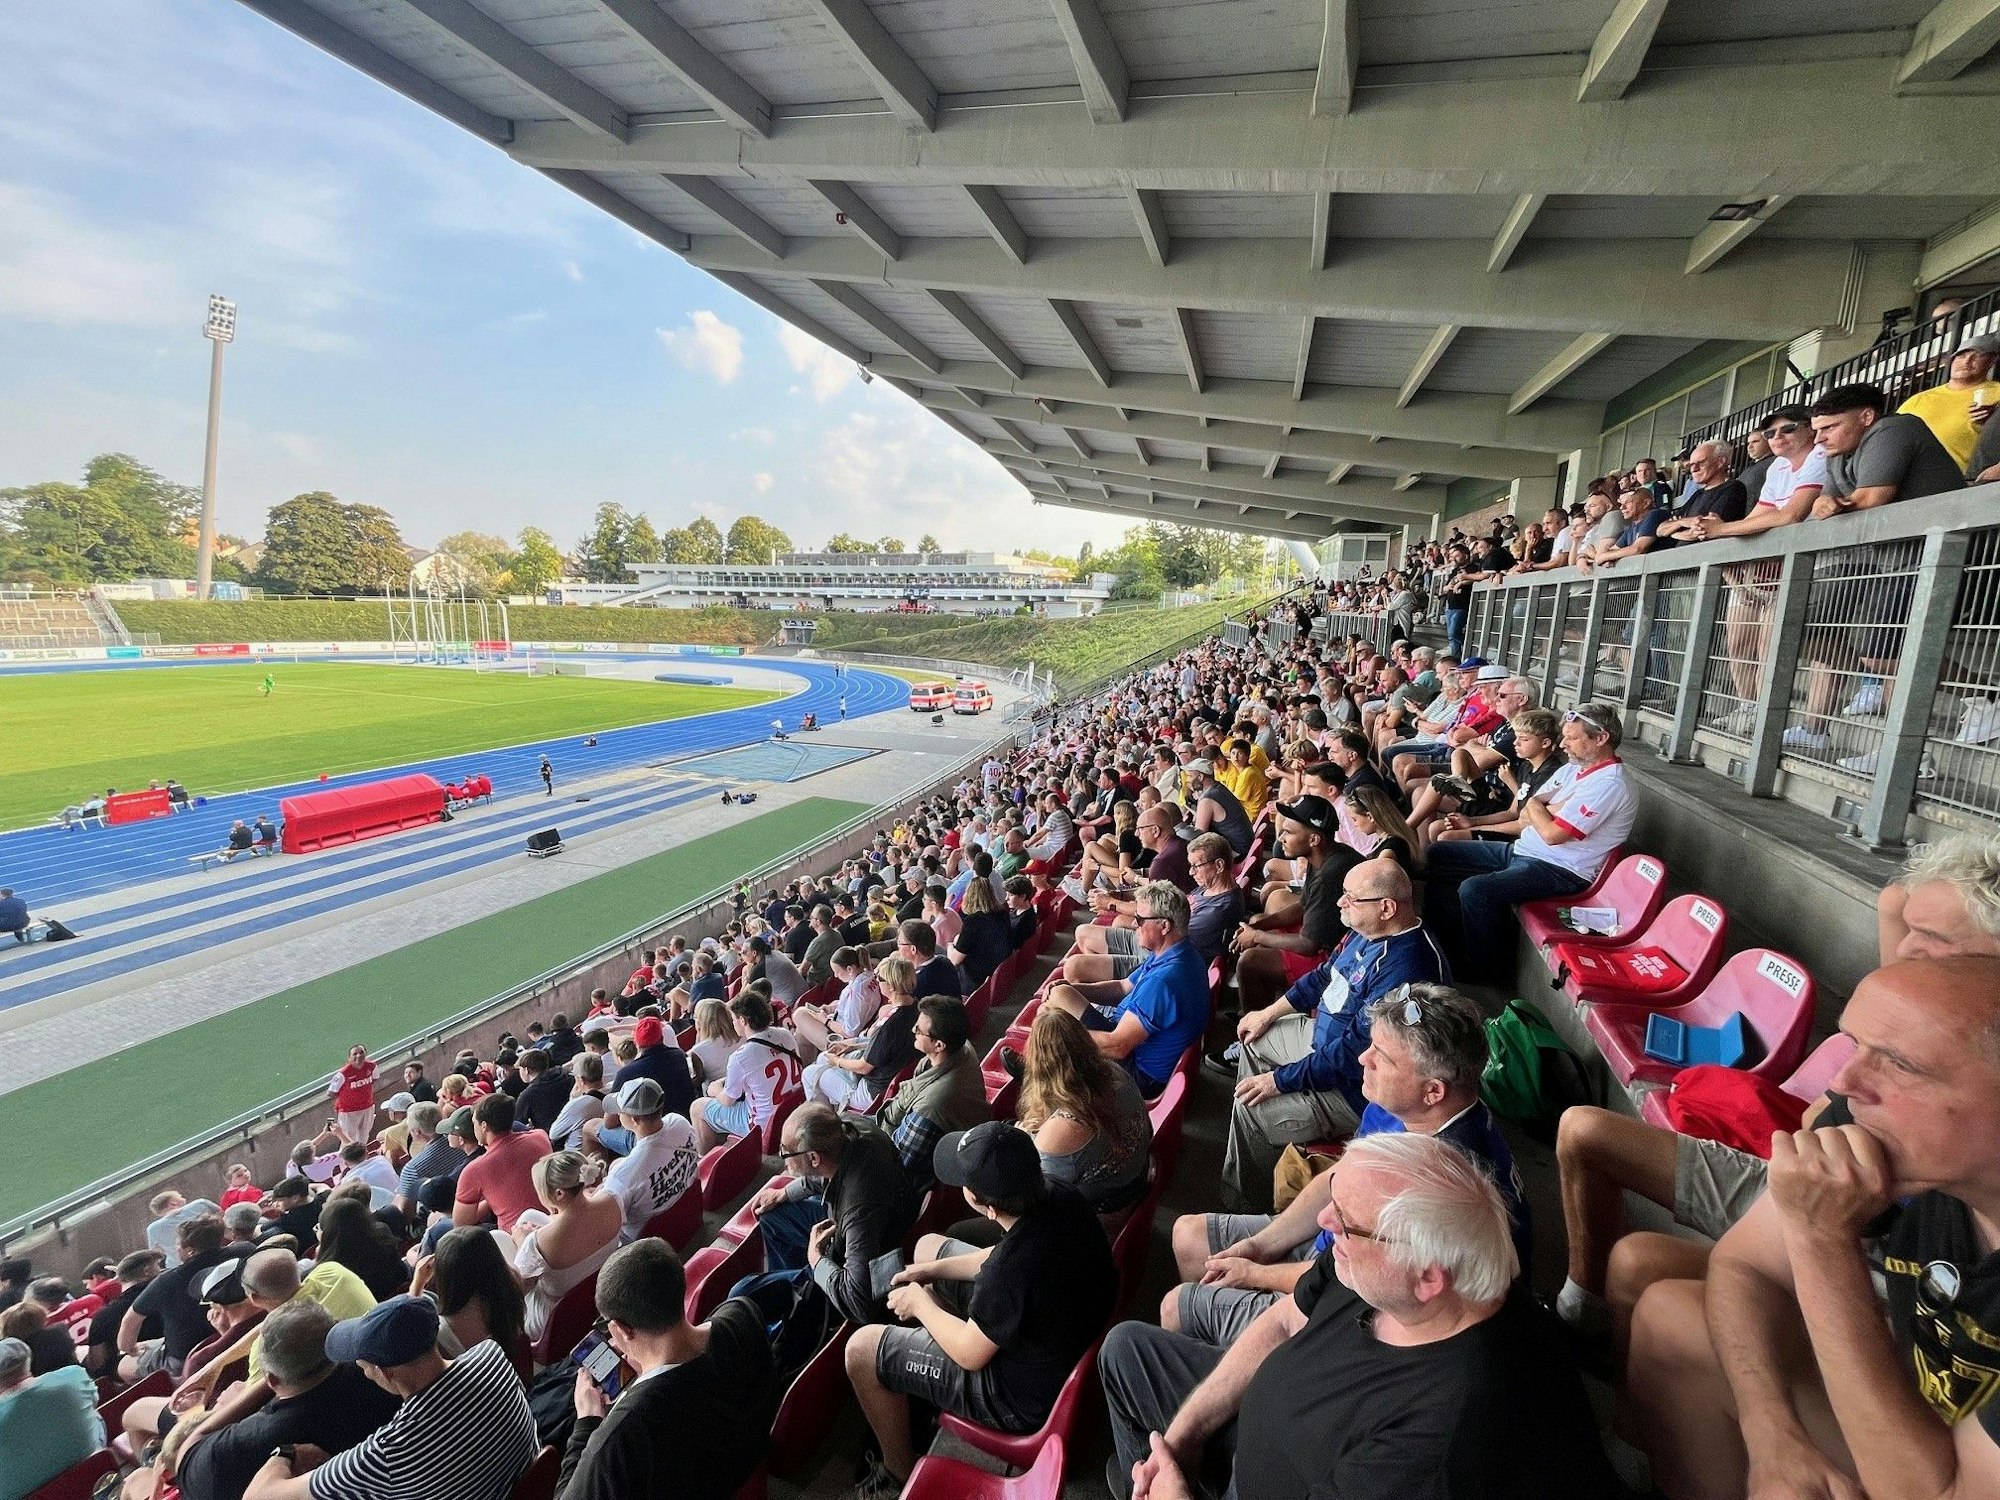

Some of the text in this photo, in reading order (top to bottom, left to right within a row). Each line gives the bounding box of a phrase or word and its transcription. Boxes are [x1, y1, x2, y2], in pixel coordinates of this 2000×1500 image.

[1640, 863, 1659, 881] PRESSE
[1695, 906, 1718, 929] PRESSE
[1765, 960, 1801, 991] PRESSE
[764, 1058, 802, 1106] 24
